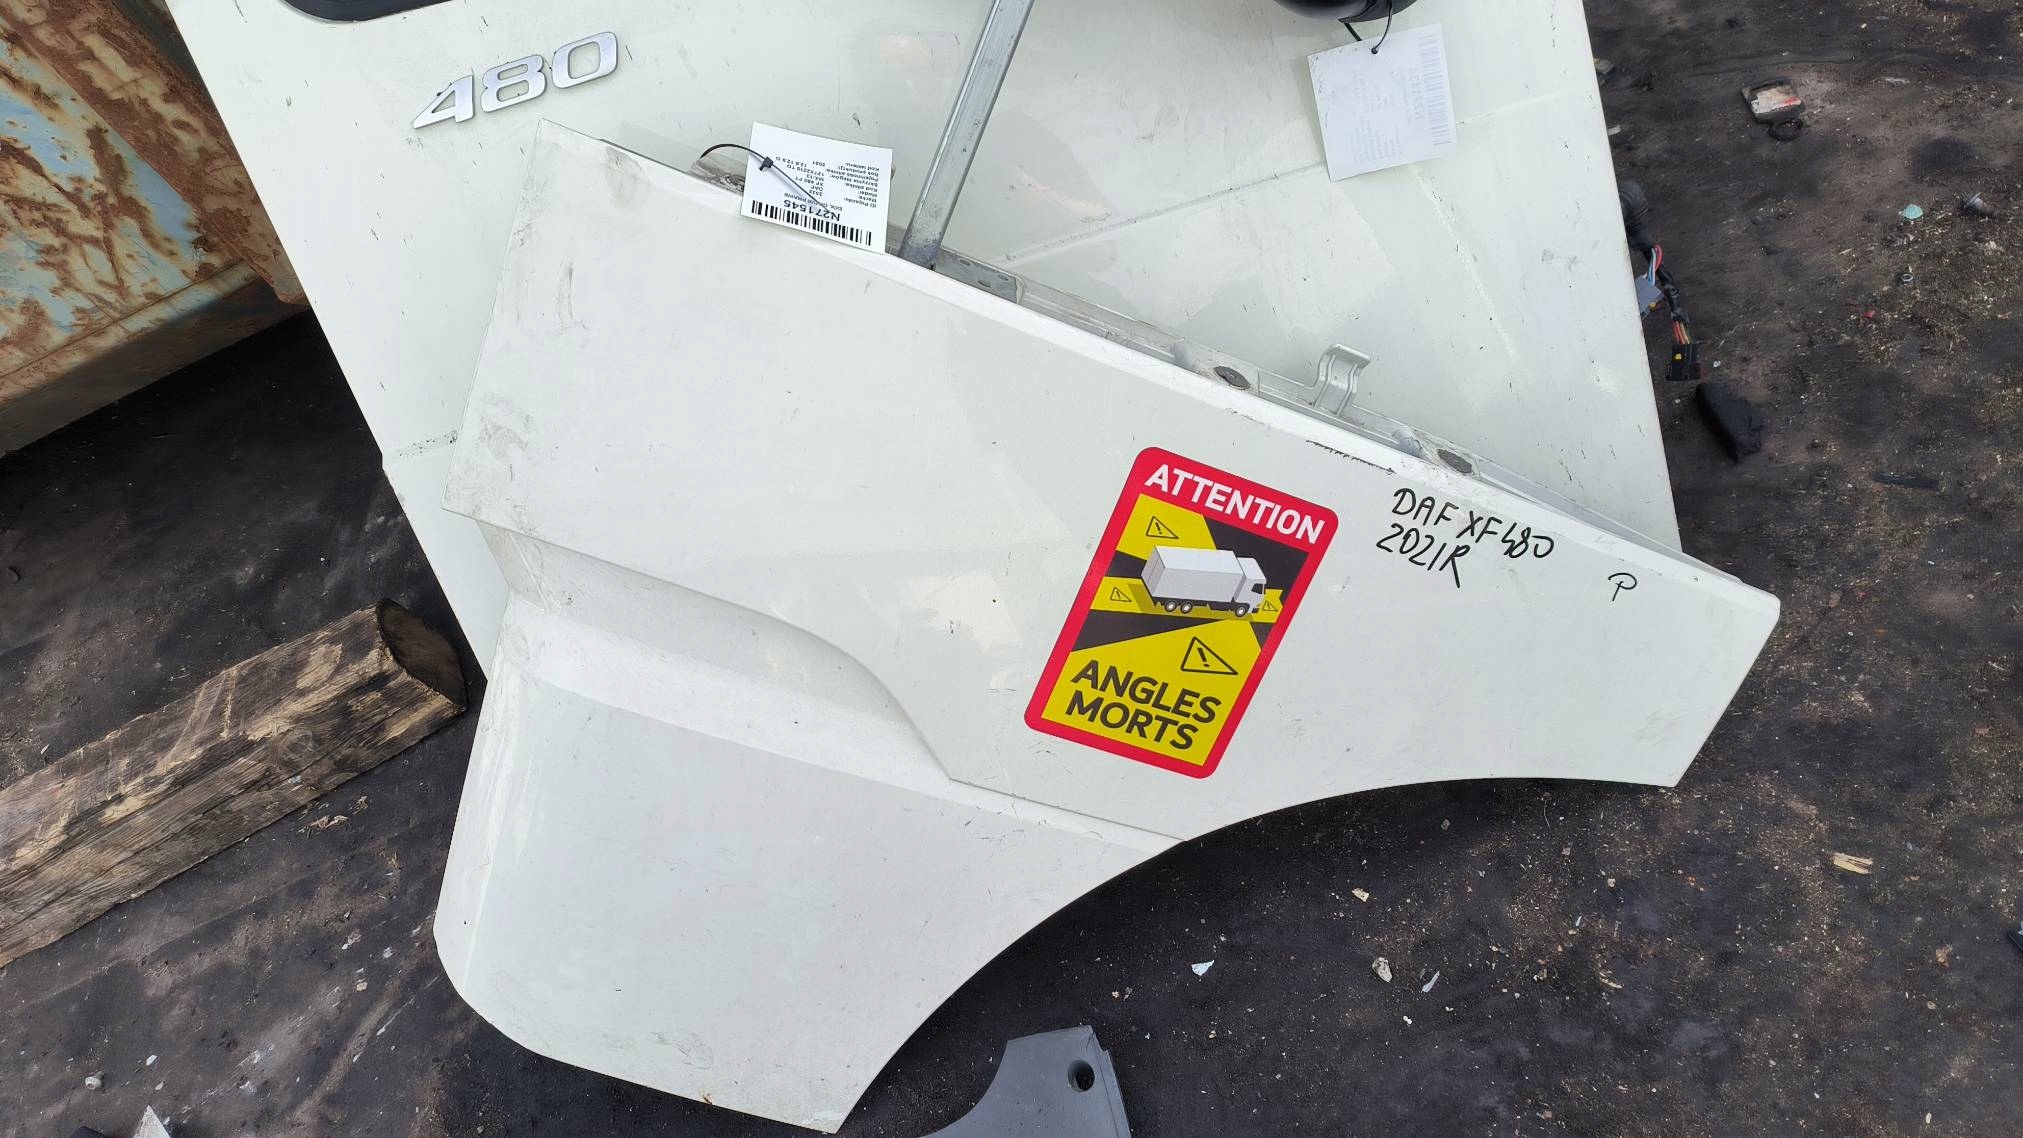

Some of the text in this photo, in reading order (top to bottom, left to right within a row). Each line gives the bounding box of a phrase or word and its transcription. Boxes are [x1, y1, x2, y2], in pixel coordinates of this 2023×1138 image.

[413, 31, 618, 129] 480
[783, 198, 840, 221] N271545
[1144, 464, 1325, 544] ATTENTION
[1391, 487, 1459, 526] DAF
[1608, 572, 1637, 601] P
[1064, 690, 1199, 750] MORTS
[1070, 659, 1222, 724] ANGLES
